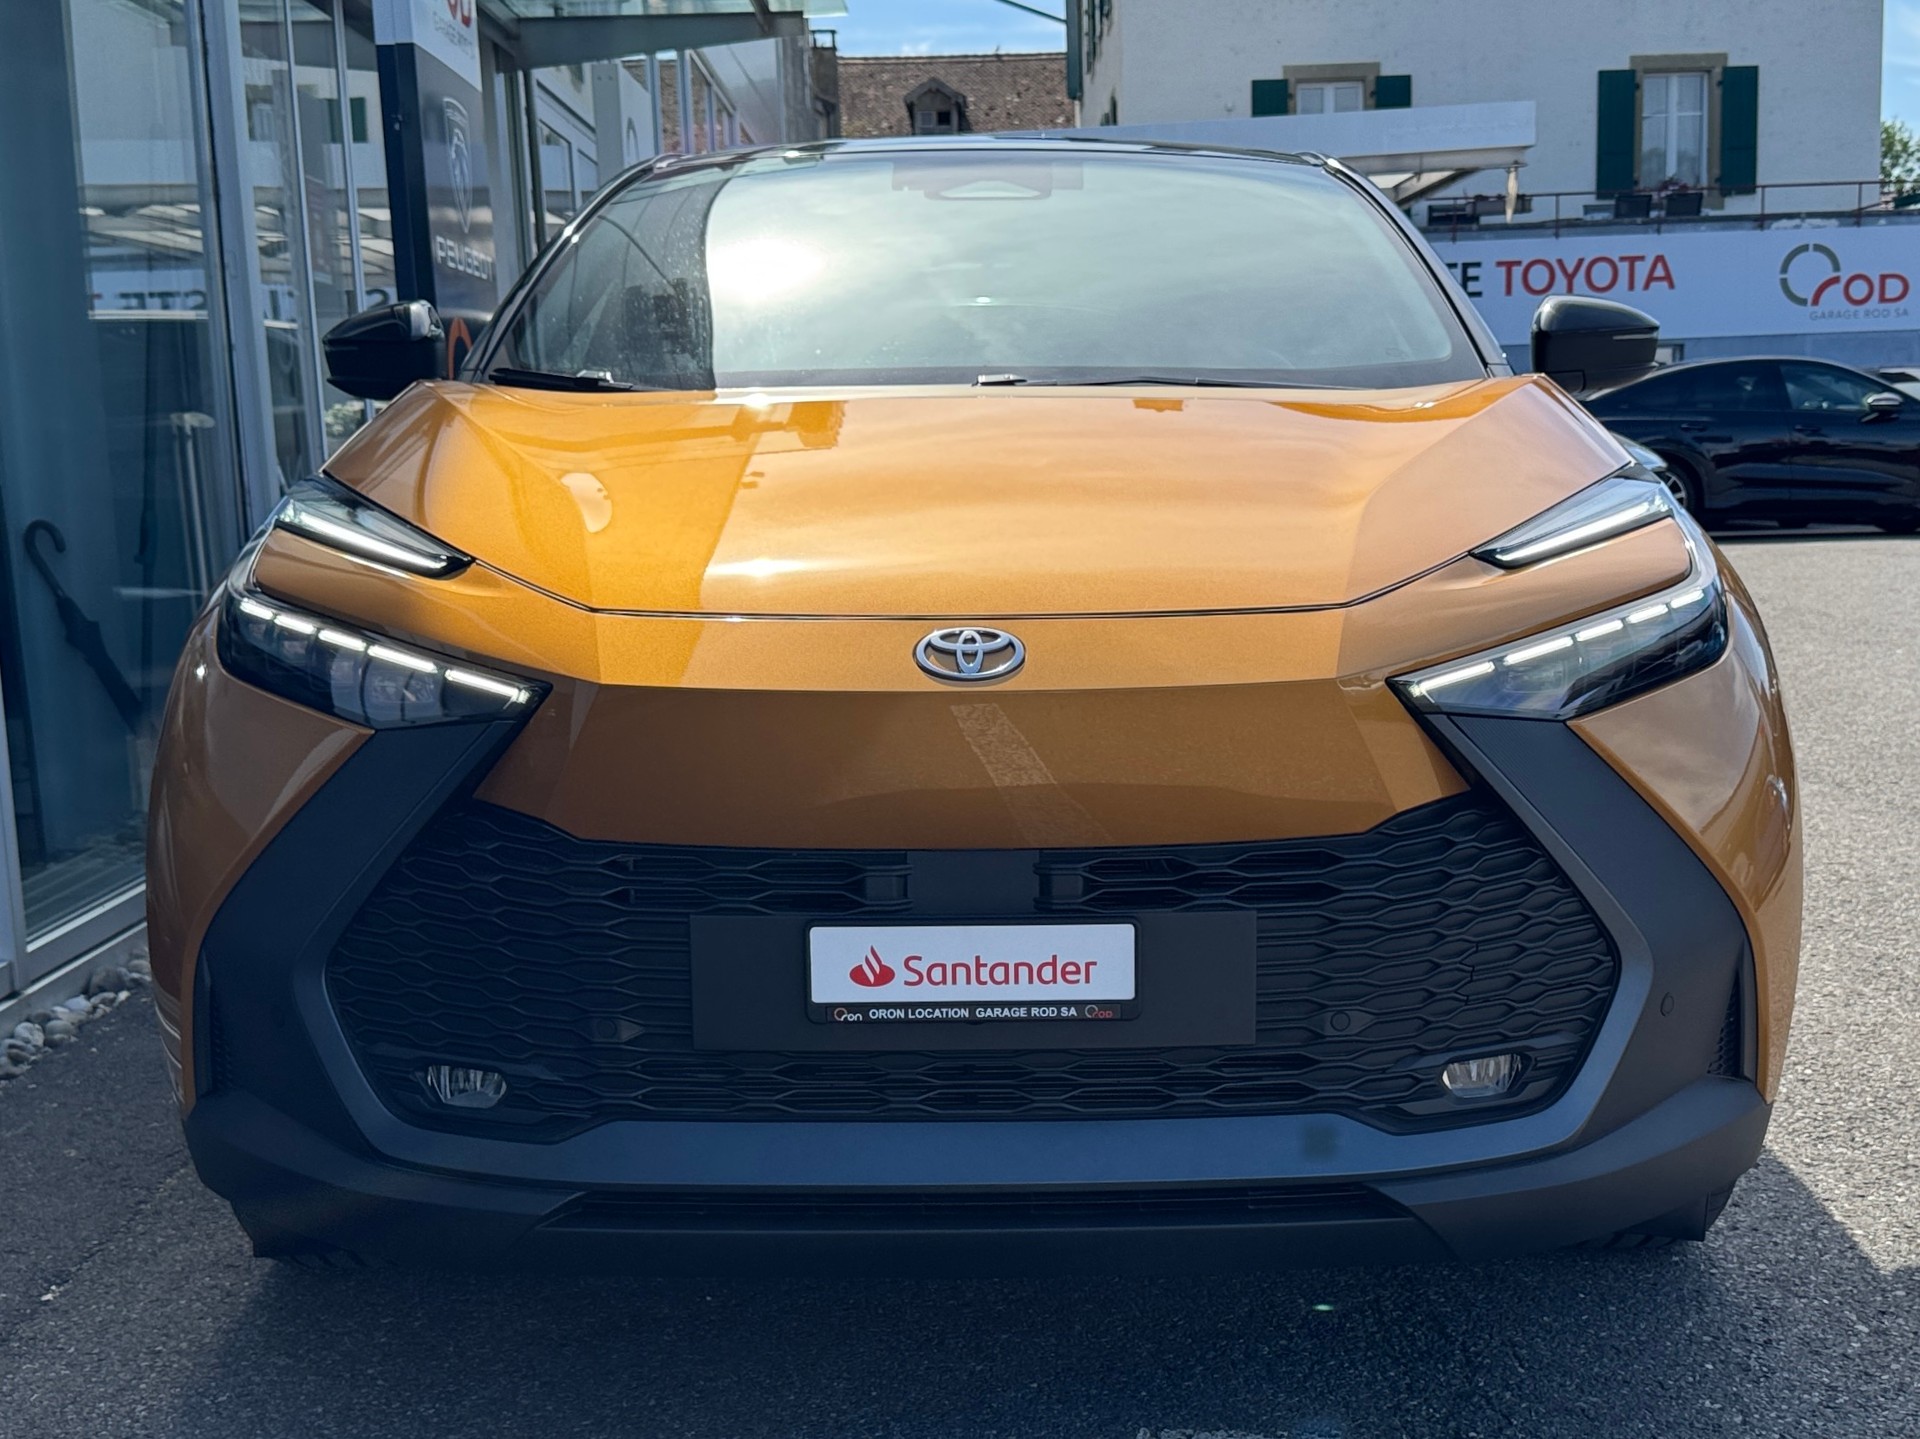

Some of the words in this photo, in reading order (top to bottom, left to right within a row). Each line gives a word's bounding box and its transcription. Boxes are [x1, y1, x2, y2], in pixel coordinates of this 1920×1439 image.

[436, 235, 493, 282] PEUGEOT
[1495, 254, 1676, 297] TOYOTA
[1809, 311, 1859, 320] GARAGE
[1894, 307, 1909, 318] SA
[903, 954, 1098, 987] Santander
[869, 1008, 905, 1019] ORON
[908, 1008, 969, 1019] LOCATION
[975, 1007, 1028, 1018] GARAGE
[1031, 1007, 1058, 1017] ROD
[1060, 1006, 1078, 1017] SA
